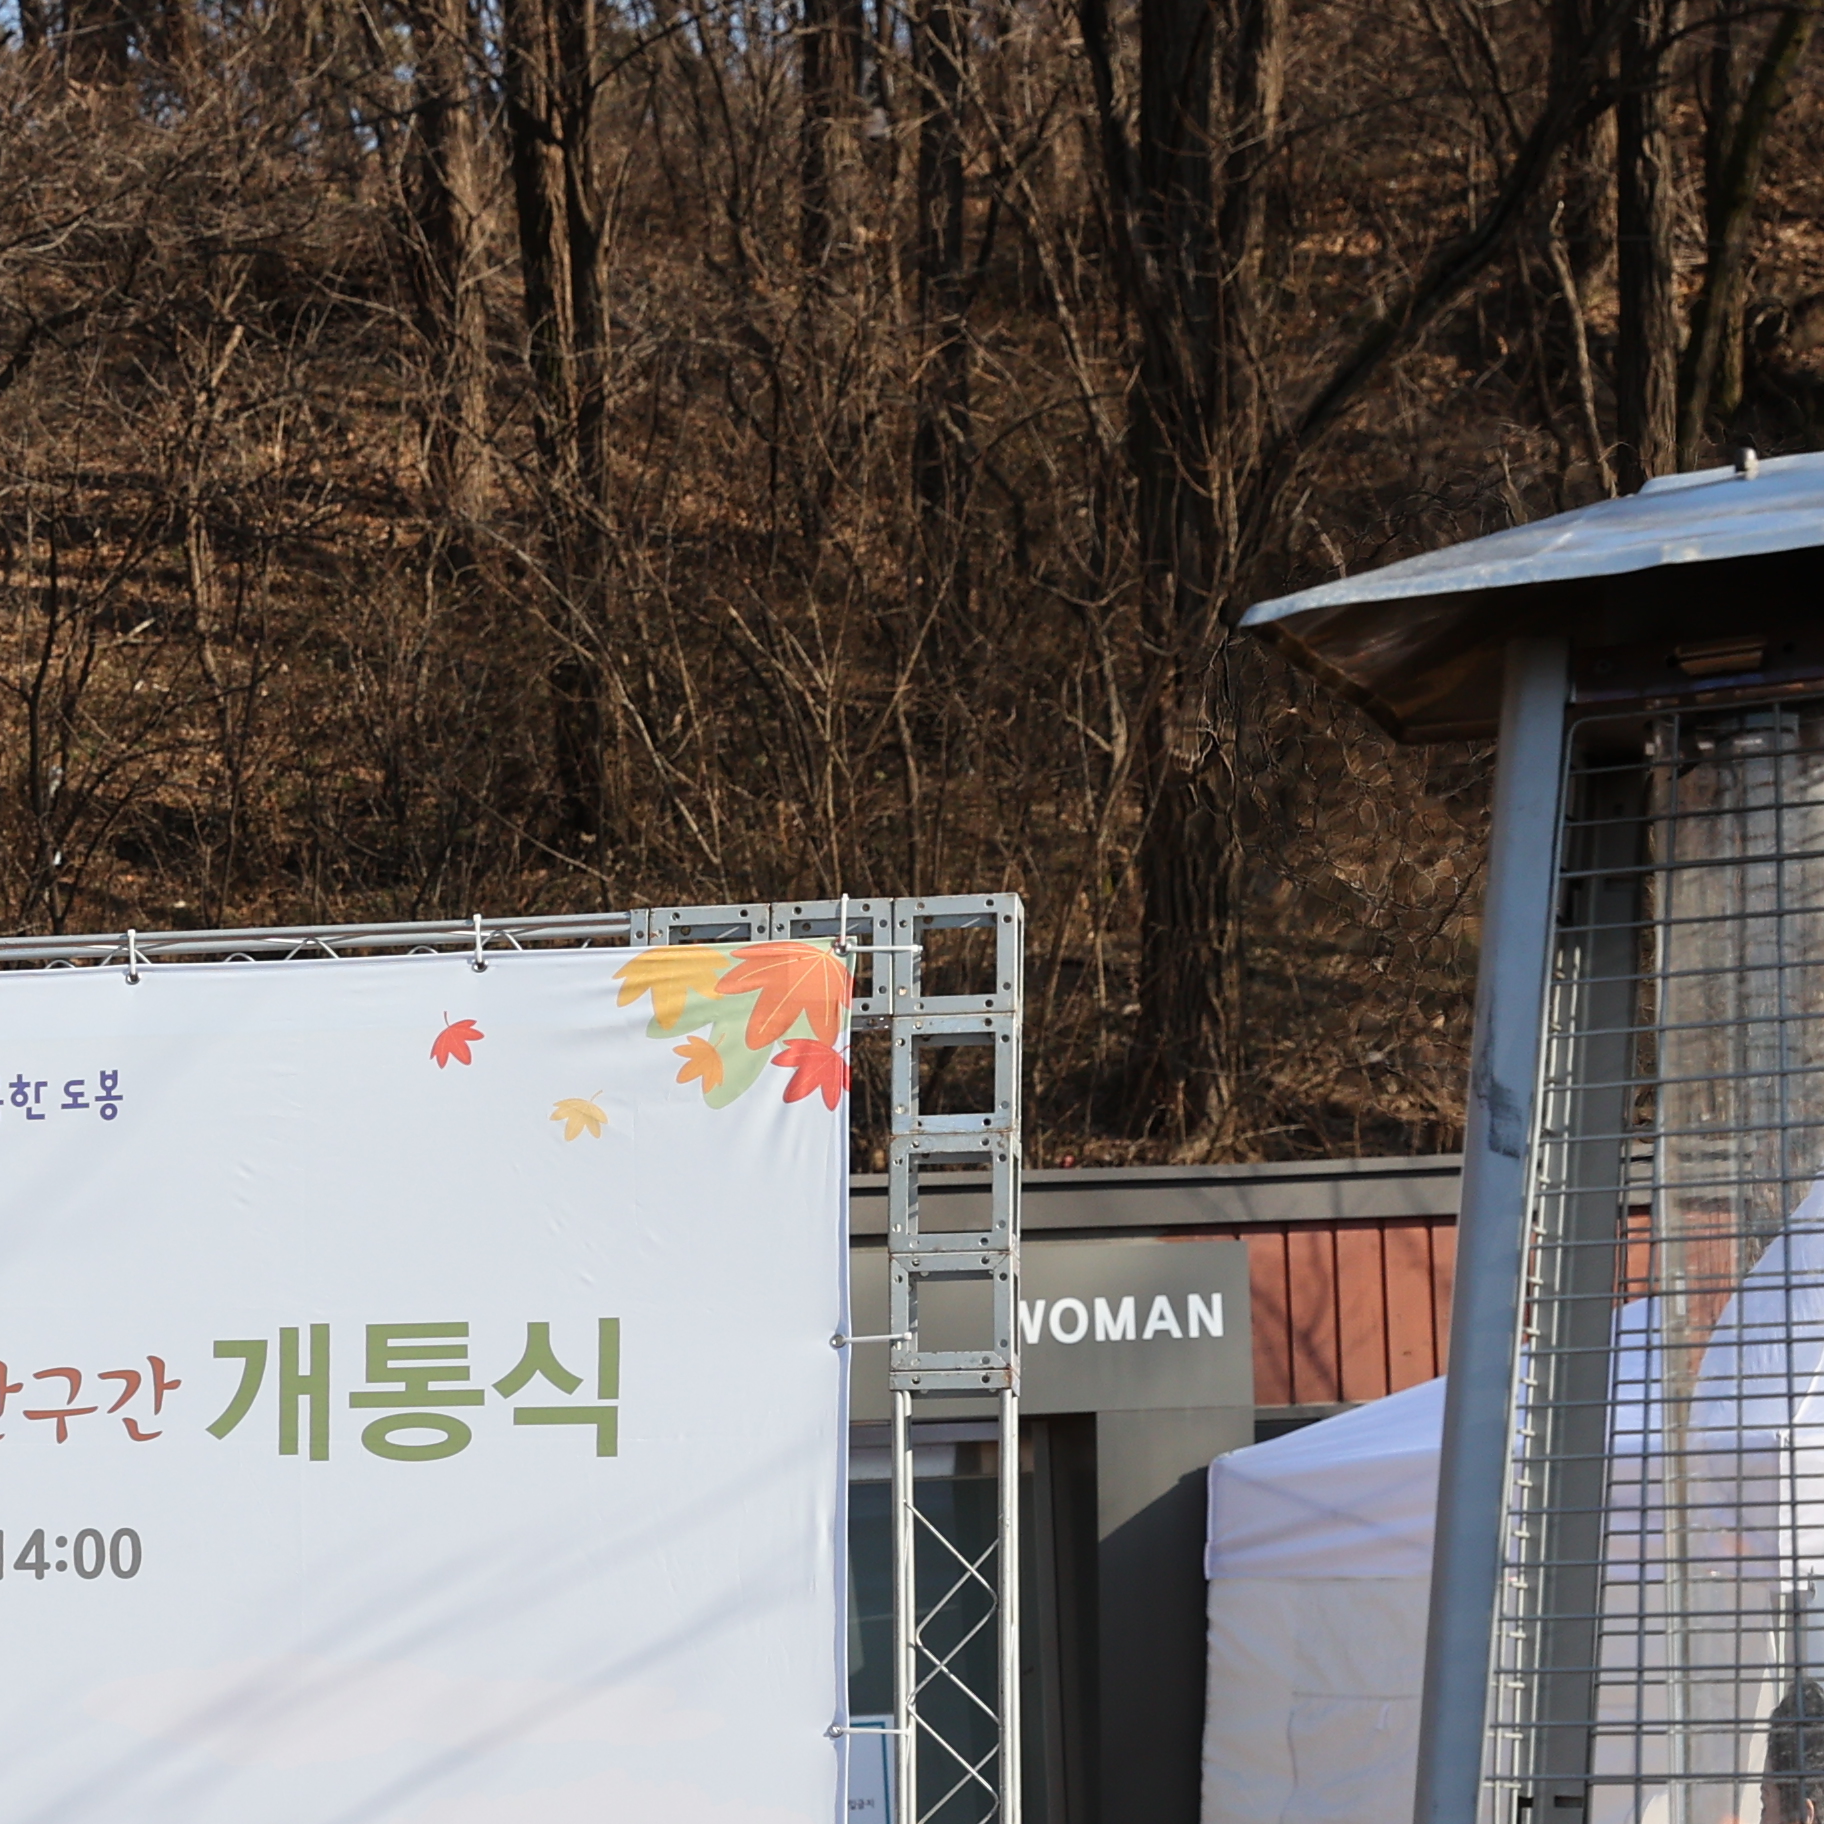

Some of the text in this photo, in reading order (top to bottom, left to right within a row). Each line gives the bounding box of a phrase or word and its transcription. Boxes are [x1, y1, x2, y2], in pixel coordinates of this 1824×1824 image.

[60, 1069, 124, 1121] 도봉
[1019, 1293, 1224, 1345] WOMAN
[205, 1317, 624, 1462] 개통식
